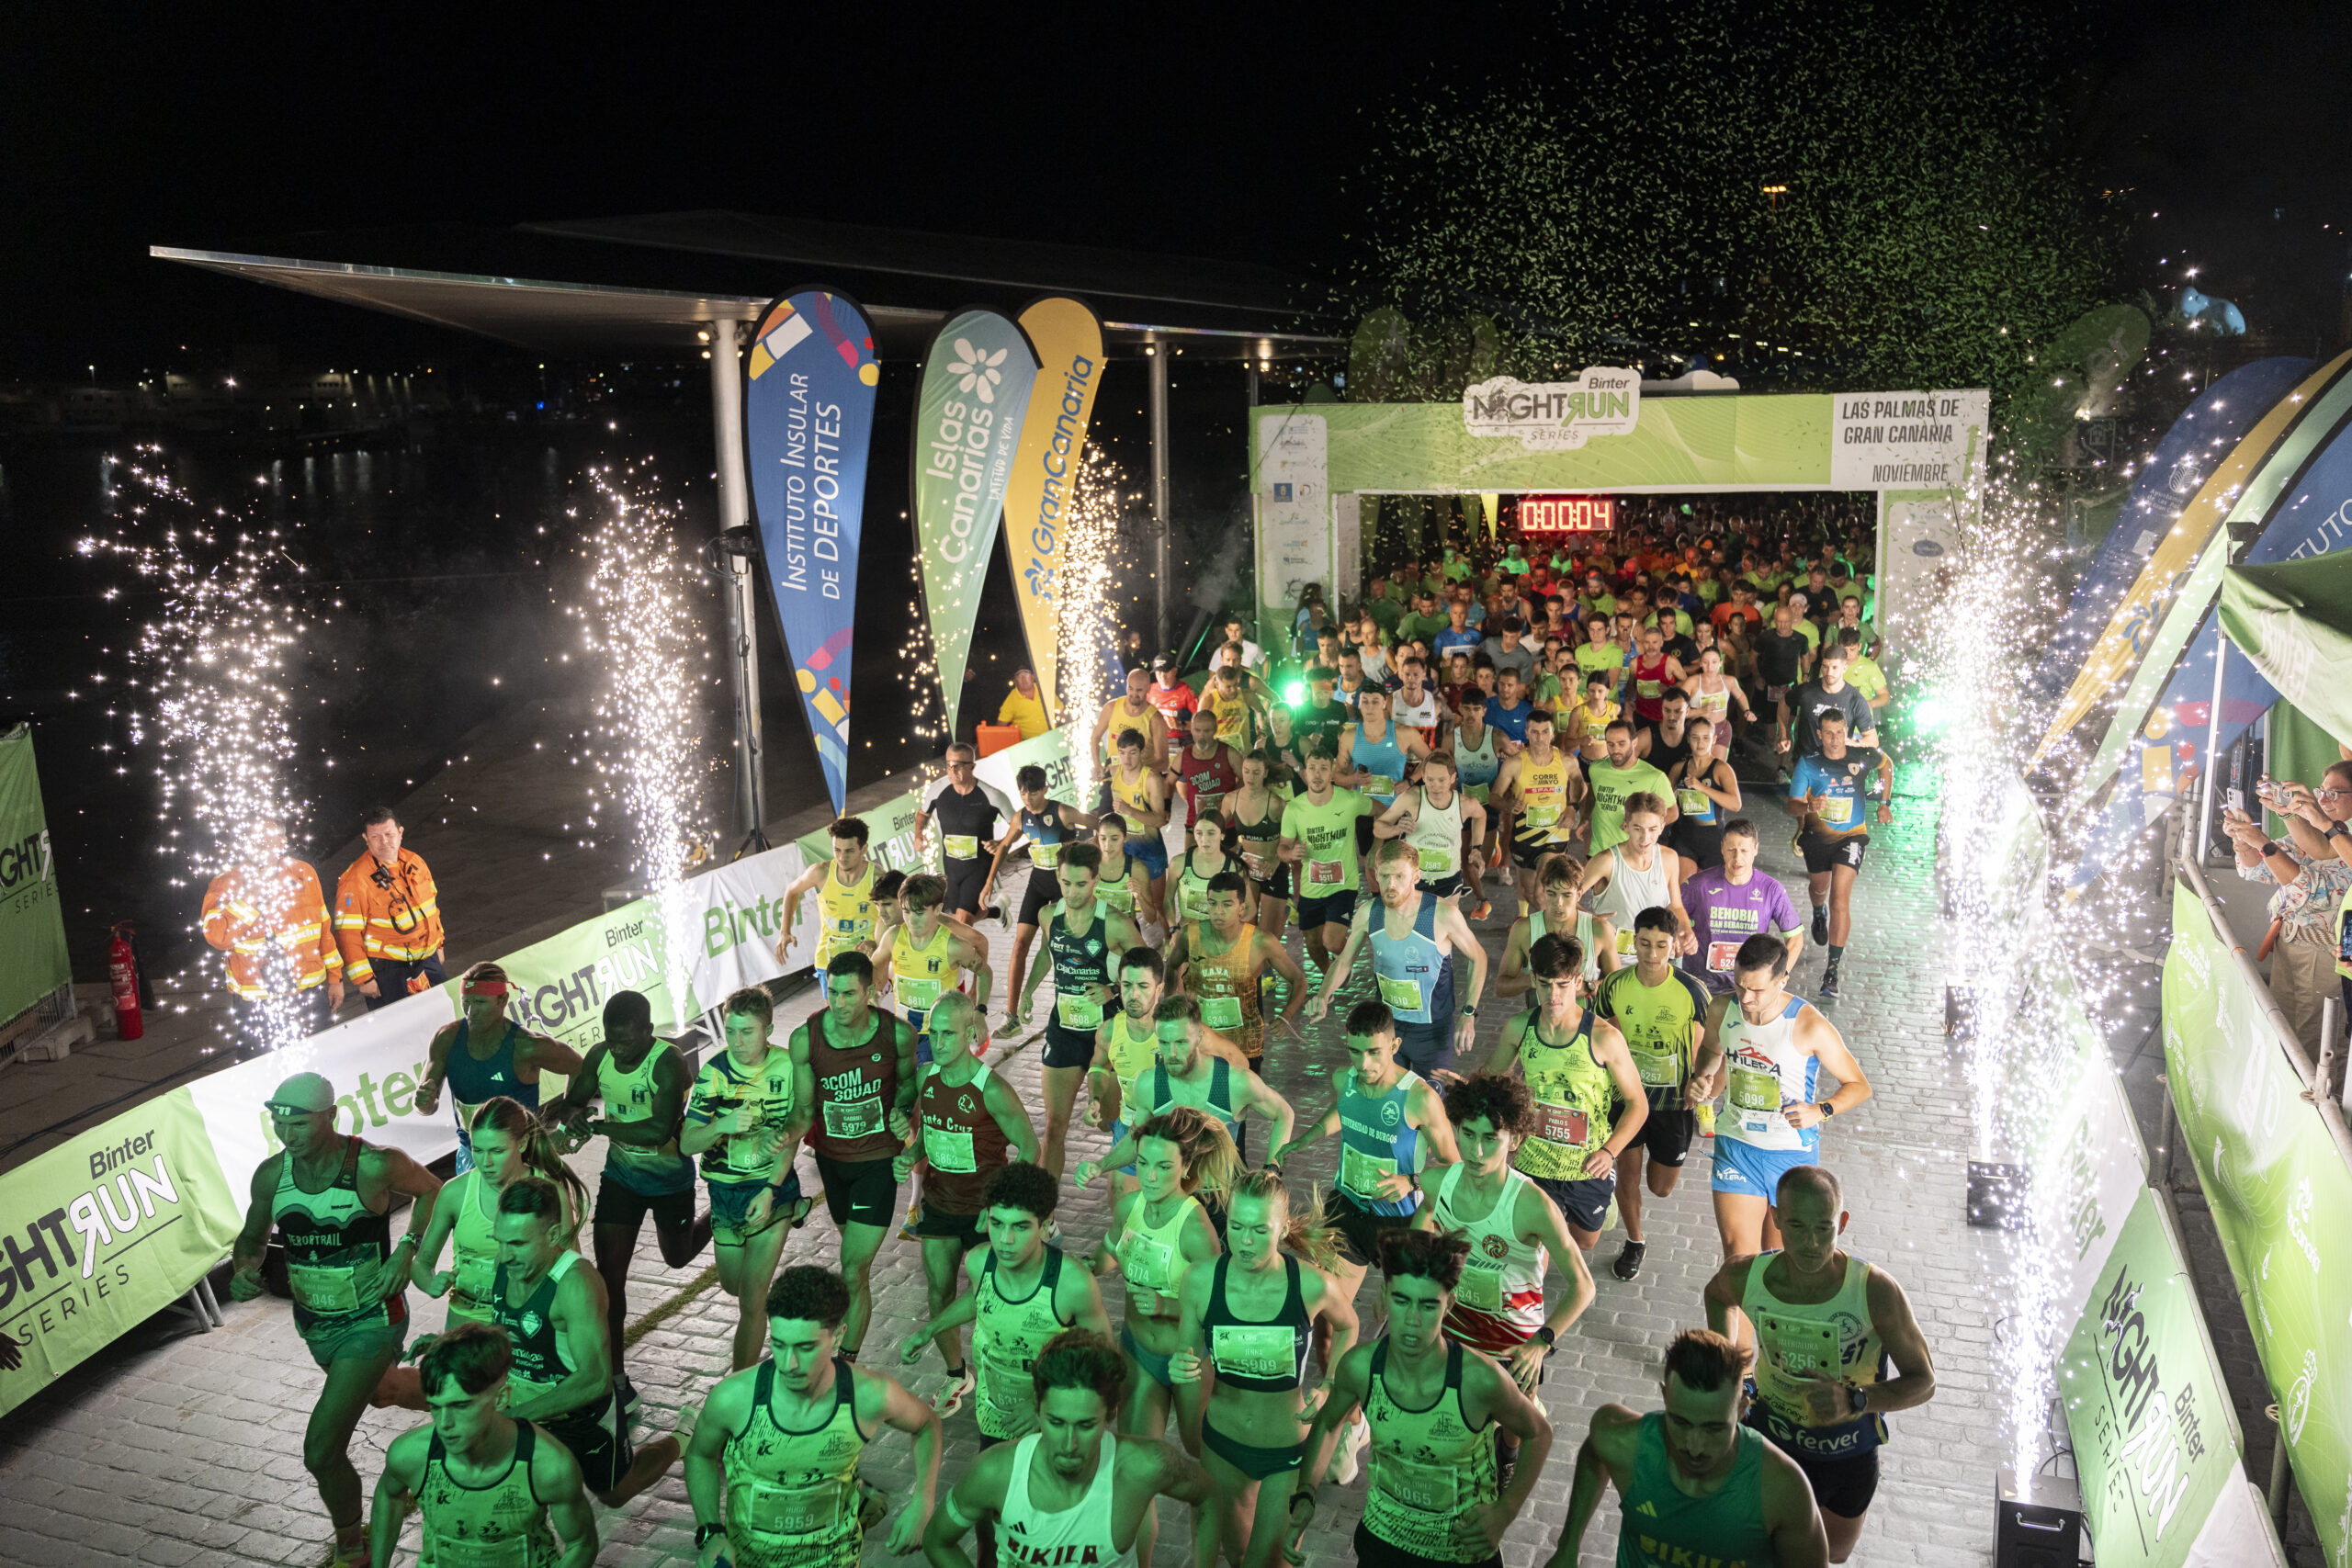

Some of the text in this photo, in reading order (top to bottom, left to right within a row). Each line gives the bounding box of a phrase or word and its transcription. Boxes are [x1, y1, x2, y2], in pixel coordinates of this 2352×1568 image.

[1589, 377, 1630, 389] Binter
[1842, 399, 1960, 420] LAS PALMAS DE
[925, 400, 967, 480] Islas
[1531, 430, 1579, 441] SERIES
[1844, 424, 1953, 444] GRAN CANARIA
[780, 372, 809, 591] INSTITUTO INSULAR
[1871, 464, 1948, 482] NOVIEMBRE
[939, 408, 993, 563] Canarias
[813, 401, 842, 600] DE DEPORTES
[15, 882, 59, 914] SERIE
[1710, 906, 1759, 923] BEHOBIA
[1710, 919, 1723, 929] SAN
[605, 919, 644, 949] Binter
[1720, 958, 1736, 968] 524
[820, 1066, 863, 1091] 3COM
[1640, 1068, 1662, 1081] 6257
[834, 1078, 882, 1102] SQUAD
[1738, 1092, 1765, 1107] 5098
[1548, 1117, 1565, 1125] PABLO
[1368, 1126, 1375, 1138] DE
[1375, 1129, 1397, 1145] BURGOS
[1544, 1124, 1571, 1140] 5755
[89, 1129, 155, 1180] Binter
[934, 1151, 959, 1165] 5863
[1126, 1263, 1149, 1281] 6774
[18, 1264, 130, 1347] SERIES
[1780, 1350, 1817, 1370] 5256
[2174, 1382, 2206, 1464] Binter
[1795, 1429, 1860, 1453] ferver
[1393, 1483, 1431, 1506] 6065
[775, 1514, 814, 1529] 5959
